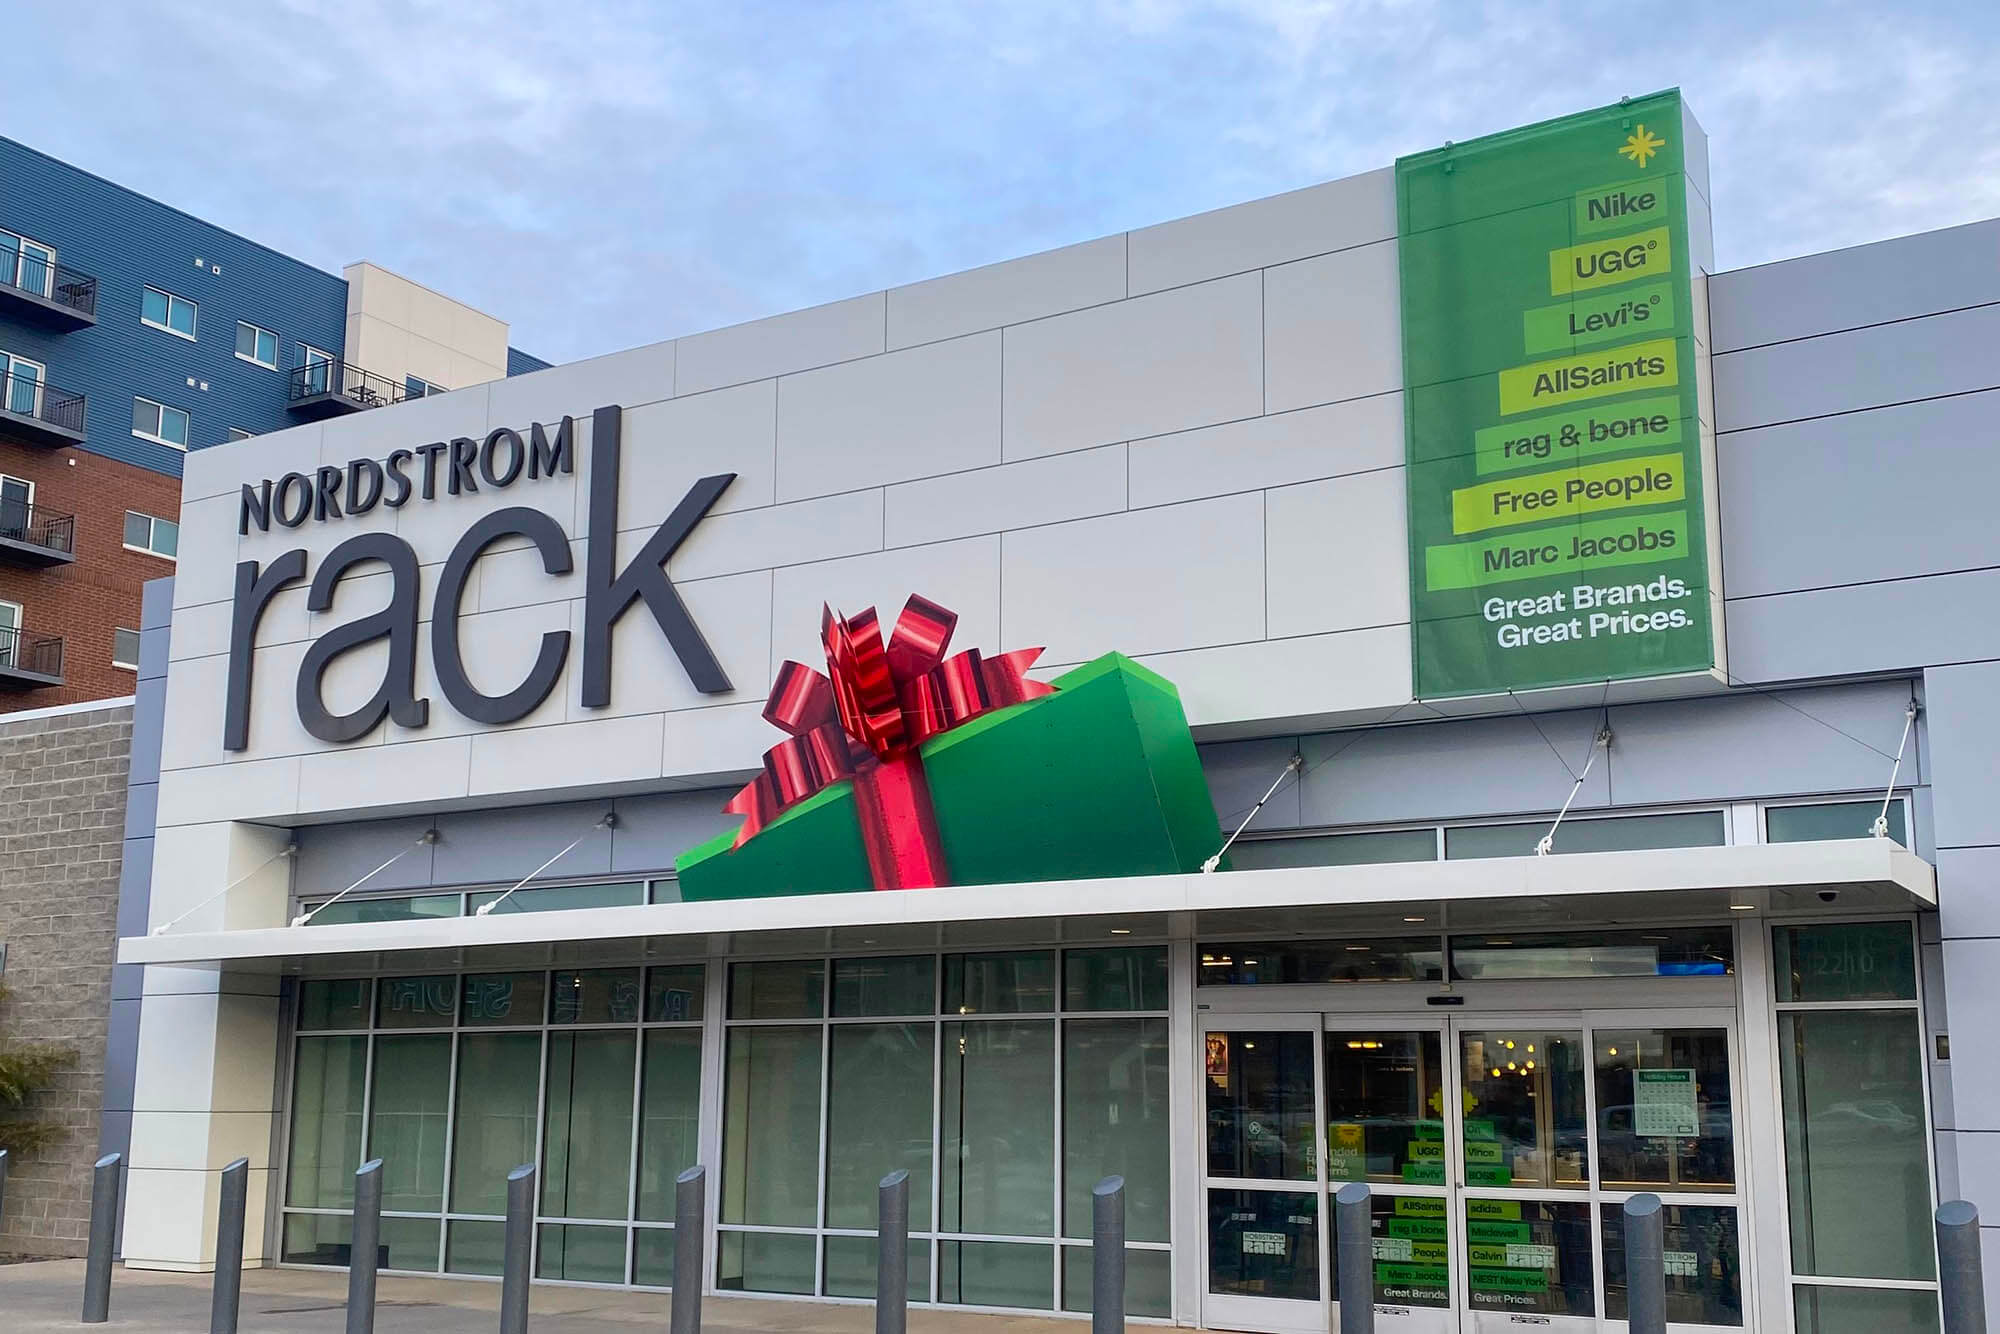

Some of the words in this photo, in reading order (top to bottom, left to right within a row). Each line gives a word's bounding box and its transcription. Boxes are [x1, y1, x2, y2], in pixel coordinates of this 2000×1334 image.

[1588, 191, 1656, 222] Nike
[1532, 355, 1665, 397] AllSaints
[1503, 433, 1551, 459] rag
[1559, 424, 1581, 448] &
[1589, 414, 1669, 443] bone
[238, 415, 574, 536] NORDSTROM
[1493, 489, 1558, 516] Free
[1566, 467, 1673, 503] People
[1483, 545, 1559, 573] Marc
[1566, 526, 1676, 560] Jacobs
[223, 405, 738, 752] rack
[1483, 591, 1566, 622] Great
[1572, 575, 1692, 610] Brands.
[1497, 618, 1582, 649] Great
[1589, 608, 1693, 638] Prices.
[1467, 1147, 1495, 1158] Vince
[1468, 1172, 1497, 1181] BOSS
[1403, 1202, 1444, 1211] AllSaints
[1470, 1204, 1502, 1213] adidas
[1413, 1247, 1446, 1259] People
[1472, 1251, 1503, 1260] Calvin
[1384, 1287, 1411, 1298] Great
[1474, 1292, 1503, 1303] Great
